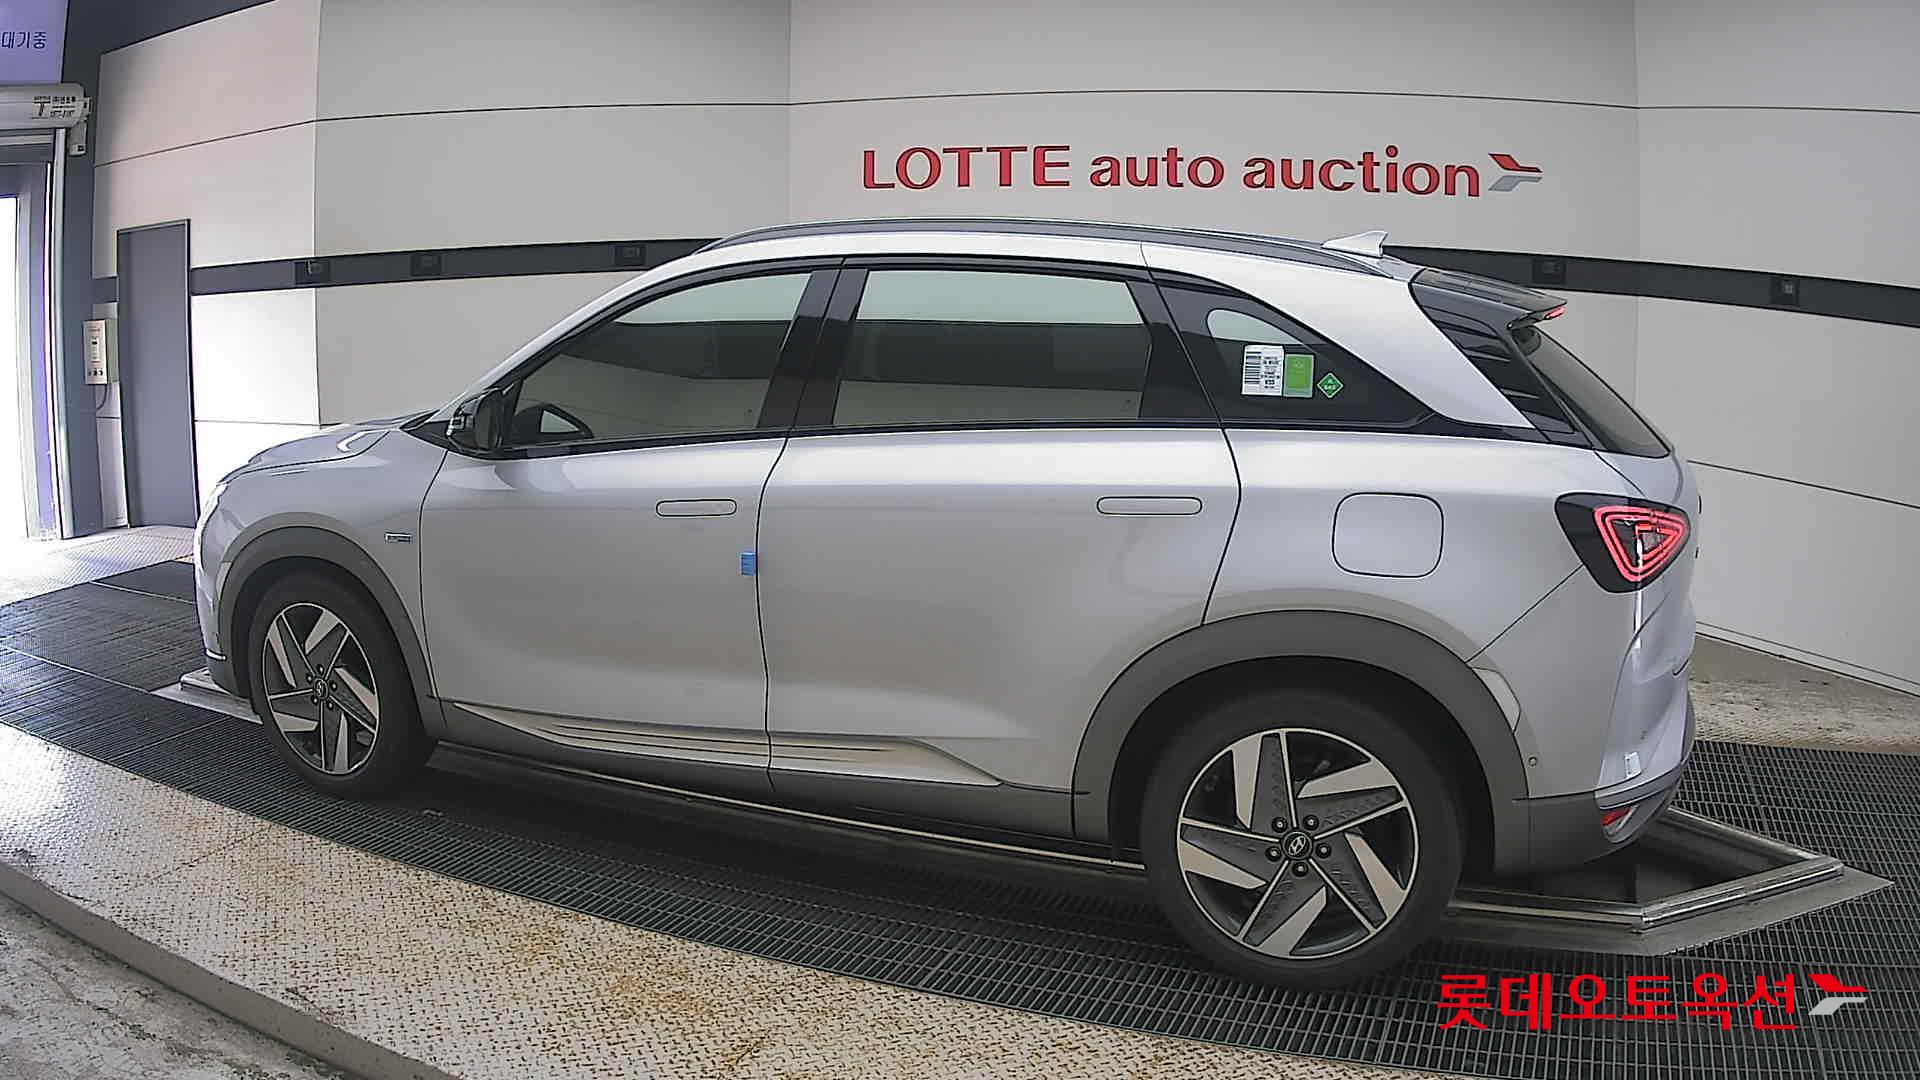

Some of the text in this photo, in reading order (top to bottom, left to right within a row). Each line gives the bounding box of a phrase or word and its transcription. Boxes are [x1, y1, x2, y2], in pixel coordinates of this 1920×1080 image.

[1, 31, 47, 49] 대기중
[863, 145, 1480, 197] LOTTE auto auction
